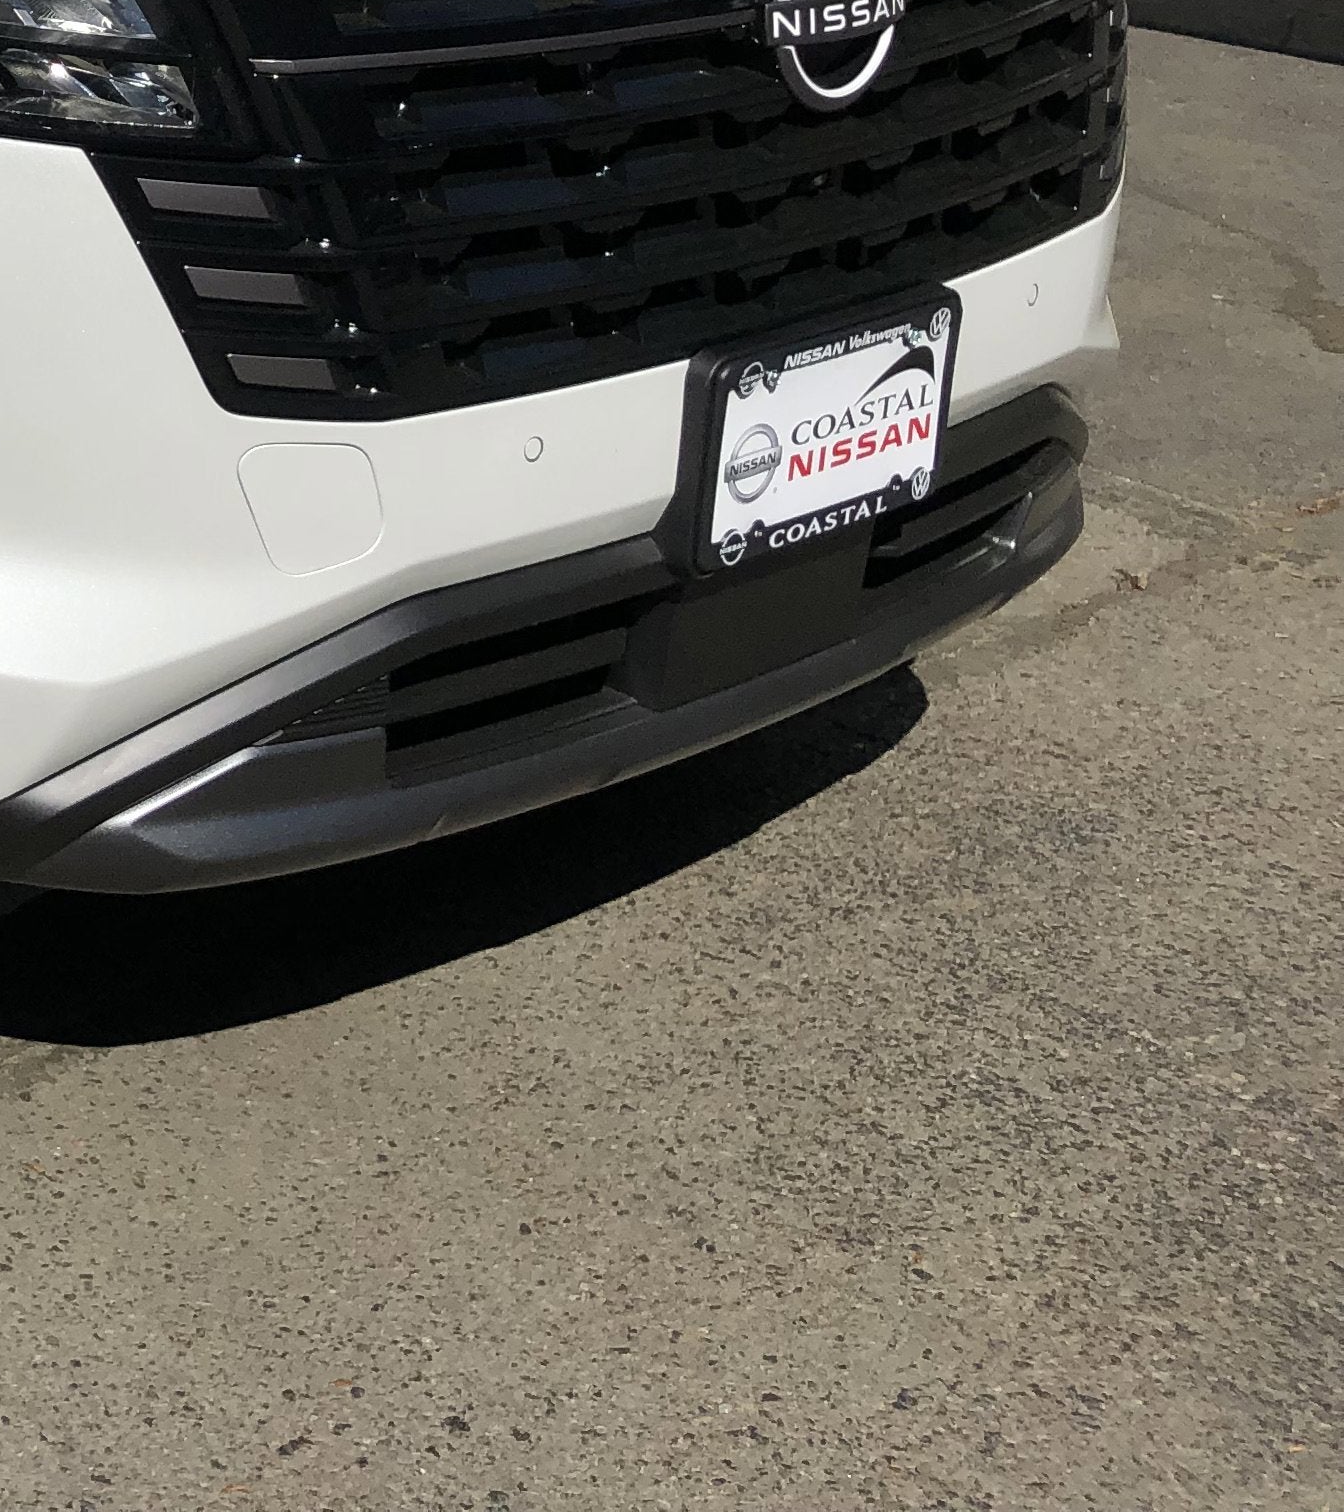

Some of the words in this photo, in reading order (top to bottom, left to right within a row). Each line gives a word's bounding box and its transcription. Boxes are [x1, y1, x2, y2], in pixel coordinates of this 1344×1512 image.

[784, 340, 846, 369] NISSAN
[849, 323, 911, 350] Volkswagen
[791, 384, 934, 446] COASTAL
[729, 451, 776, 477] NISSAN
[788, 413, 931, 481] NISSAN
[768, 495, 888, 549] COASTAL
